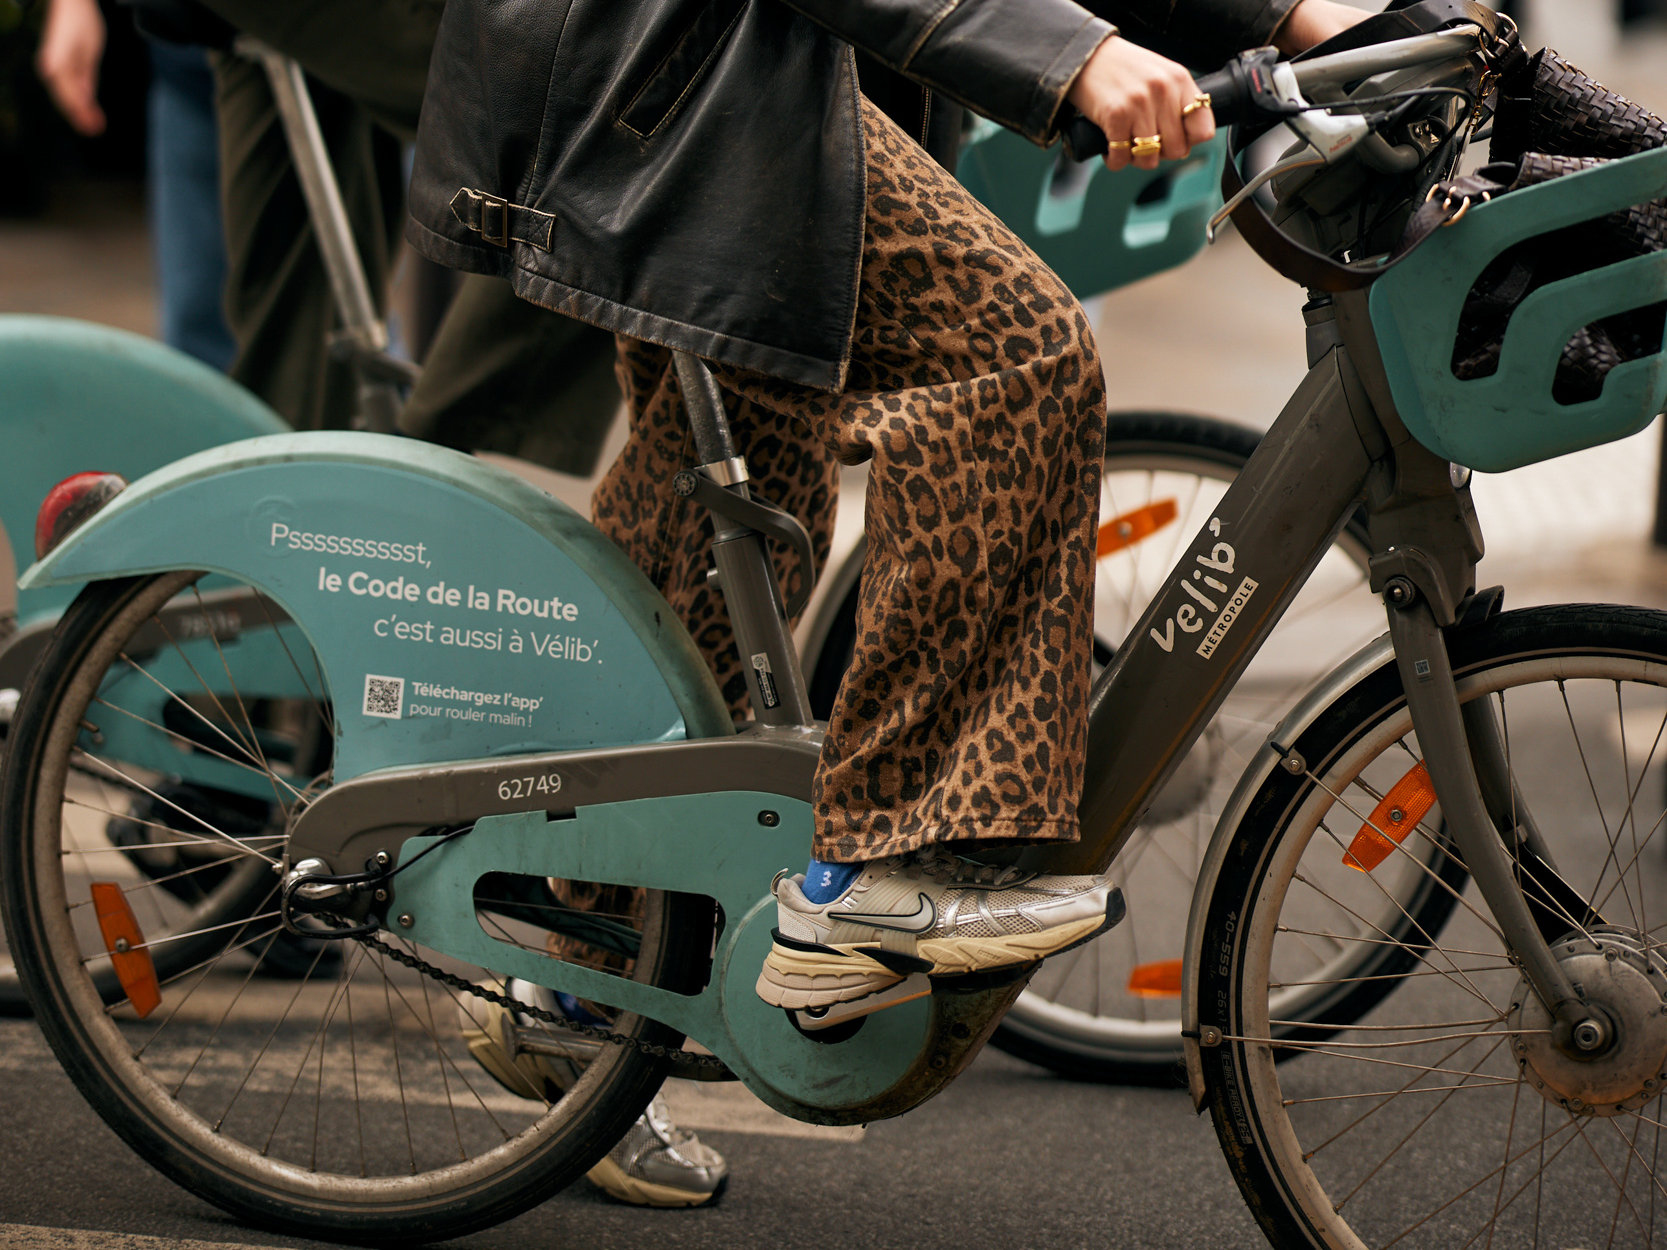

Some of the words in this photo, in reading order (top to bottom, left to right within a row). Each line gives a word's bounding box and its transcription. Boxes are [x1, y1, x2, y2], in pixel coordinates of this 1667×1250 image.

[318, 566, 343, 593] le
[347, 571, 421, 602] Code
[426, 581, 462, 607] de
[467, 584, 490, 611] la
[496, 588, 579, 622] Route
[373, 613, 435, 643] c'est
[439, 626, 503, 651] aussi
[508, 628, 523, 654] à
[411, 681, 502, 706] Téléchargez
[409, 703, 443, 718] pour
[445, 707, 486, 722] rouler
[489, 711, 526, 727] malin
[498, 773, 561, 800] 62749
[1219, 910, 1237, 977] 40-559
